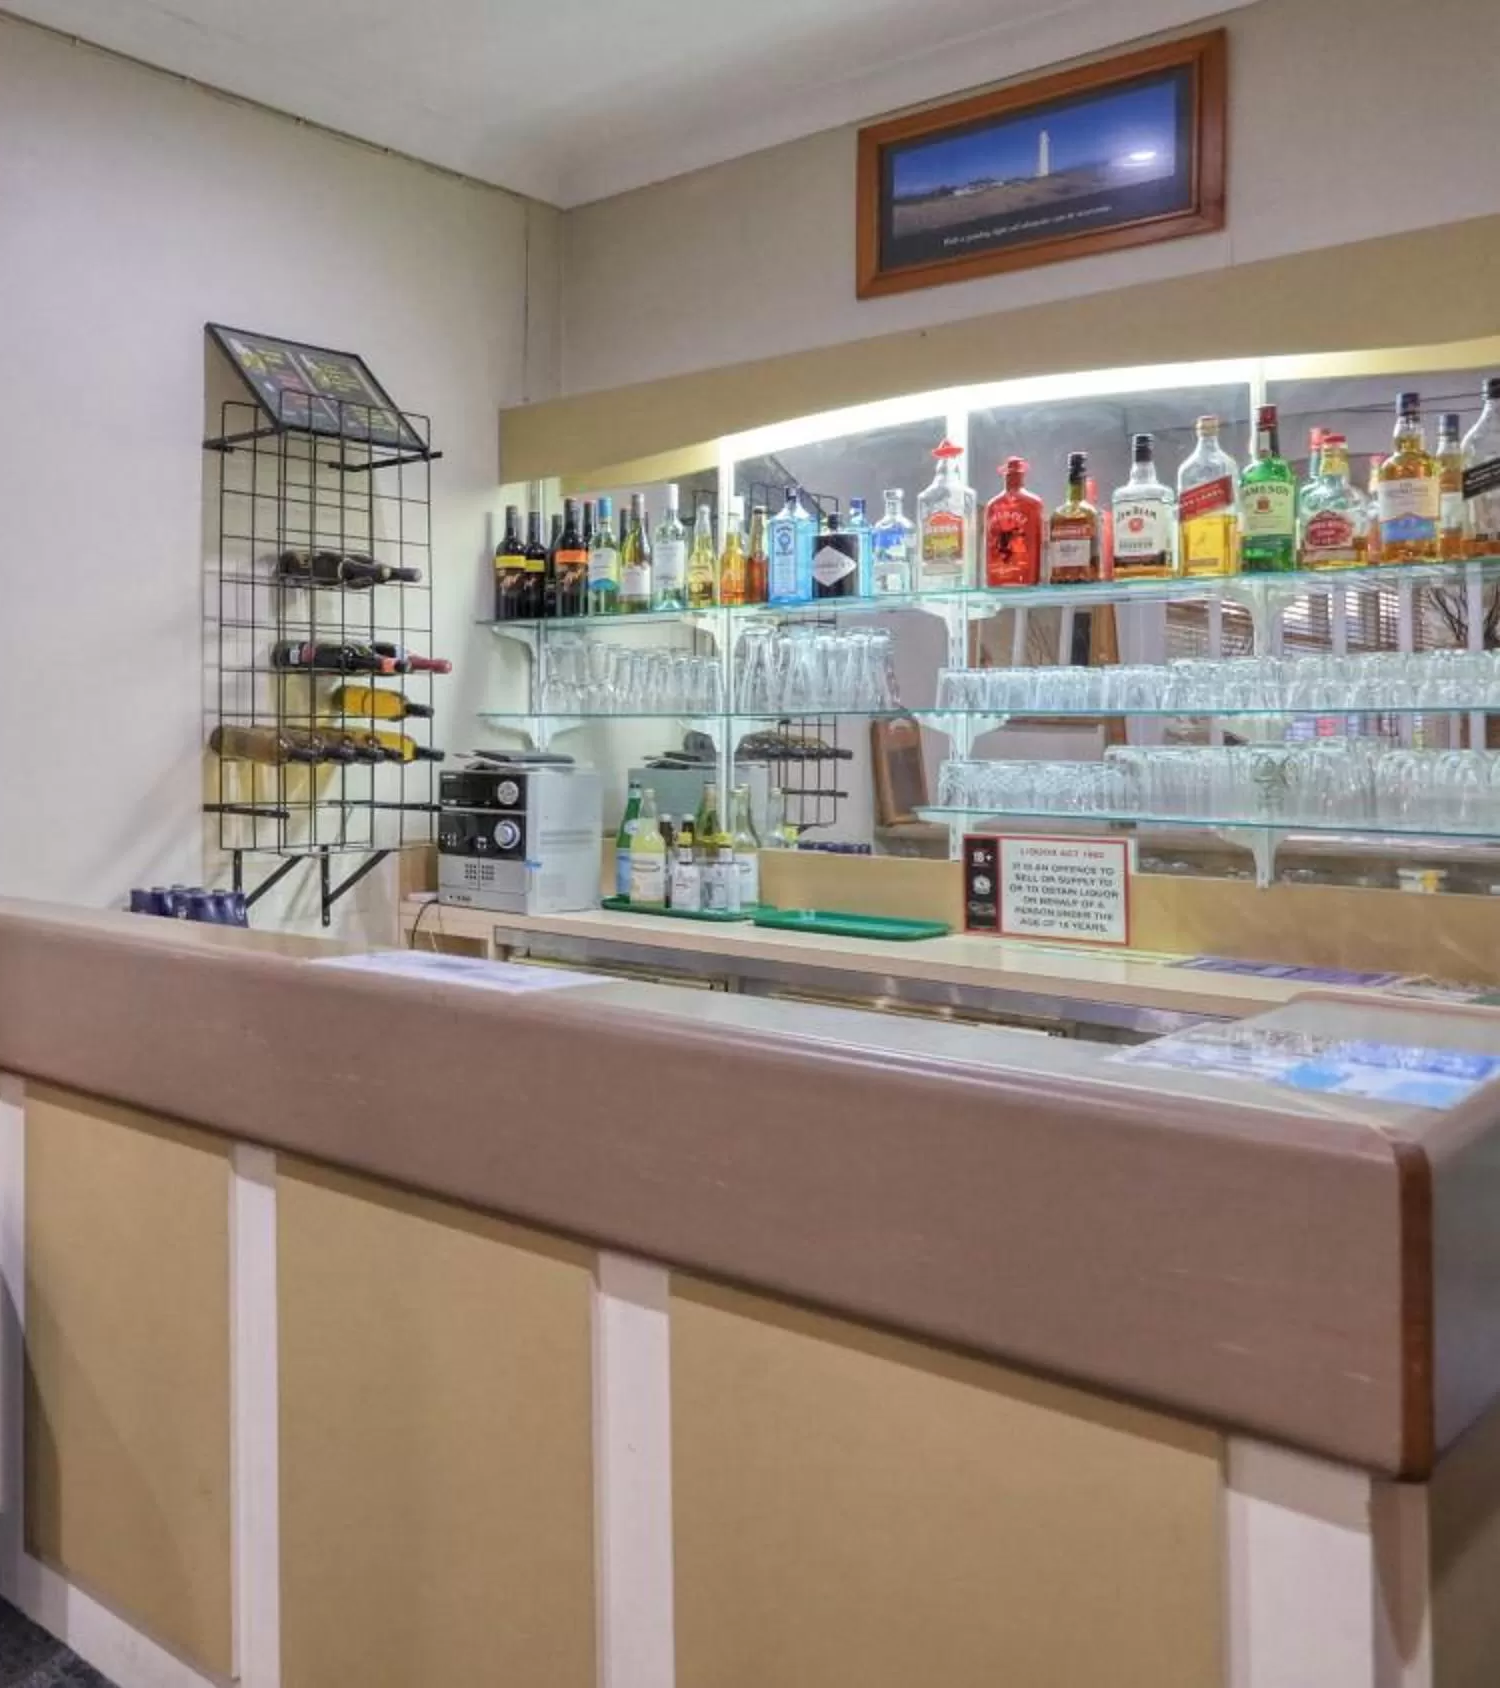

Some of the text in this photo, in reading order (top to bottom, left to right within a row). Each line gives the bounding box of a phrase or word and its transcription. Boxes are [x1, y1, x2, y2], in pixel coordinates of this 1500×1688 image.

[1132, 506, 1157, 521] BEAM
[973, 851, 993, 863] 18+
[1035, 864, 1049, 872] AN
[1052, 864, 1097, 875] OFFENCE
[1099, 867, 1115, 876] TO
[1015, 873, 1113, 887] SELL OR SUPPLY TO
[1027, 885, 1039, 893] TO
[1041, 886, 1077, 896] OBTAIN
[1079, 888, 1119, 899] LIQUOR
[1023, 896, 1037, 905] ON
[1040, 897, 1078, 907] BEHALF
[1081, 899, 1094, 909] OF
[1014, 906, 1113, 921] PERSON UNDER THE
[1020, 918, 1039, 927] AGE
